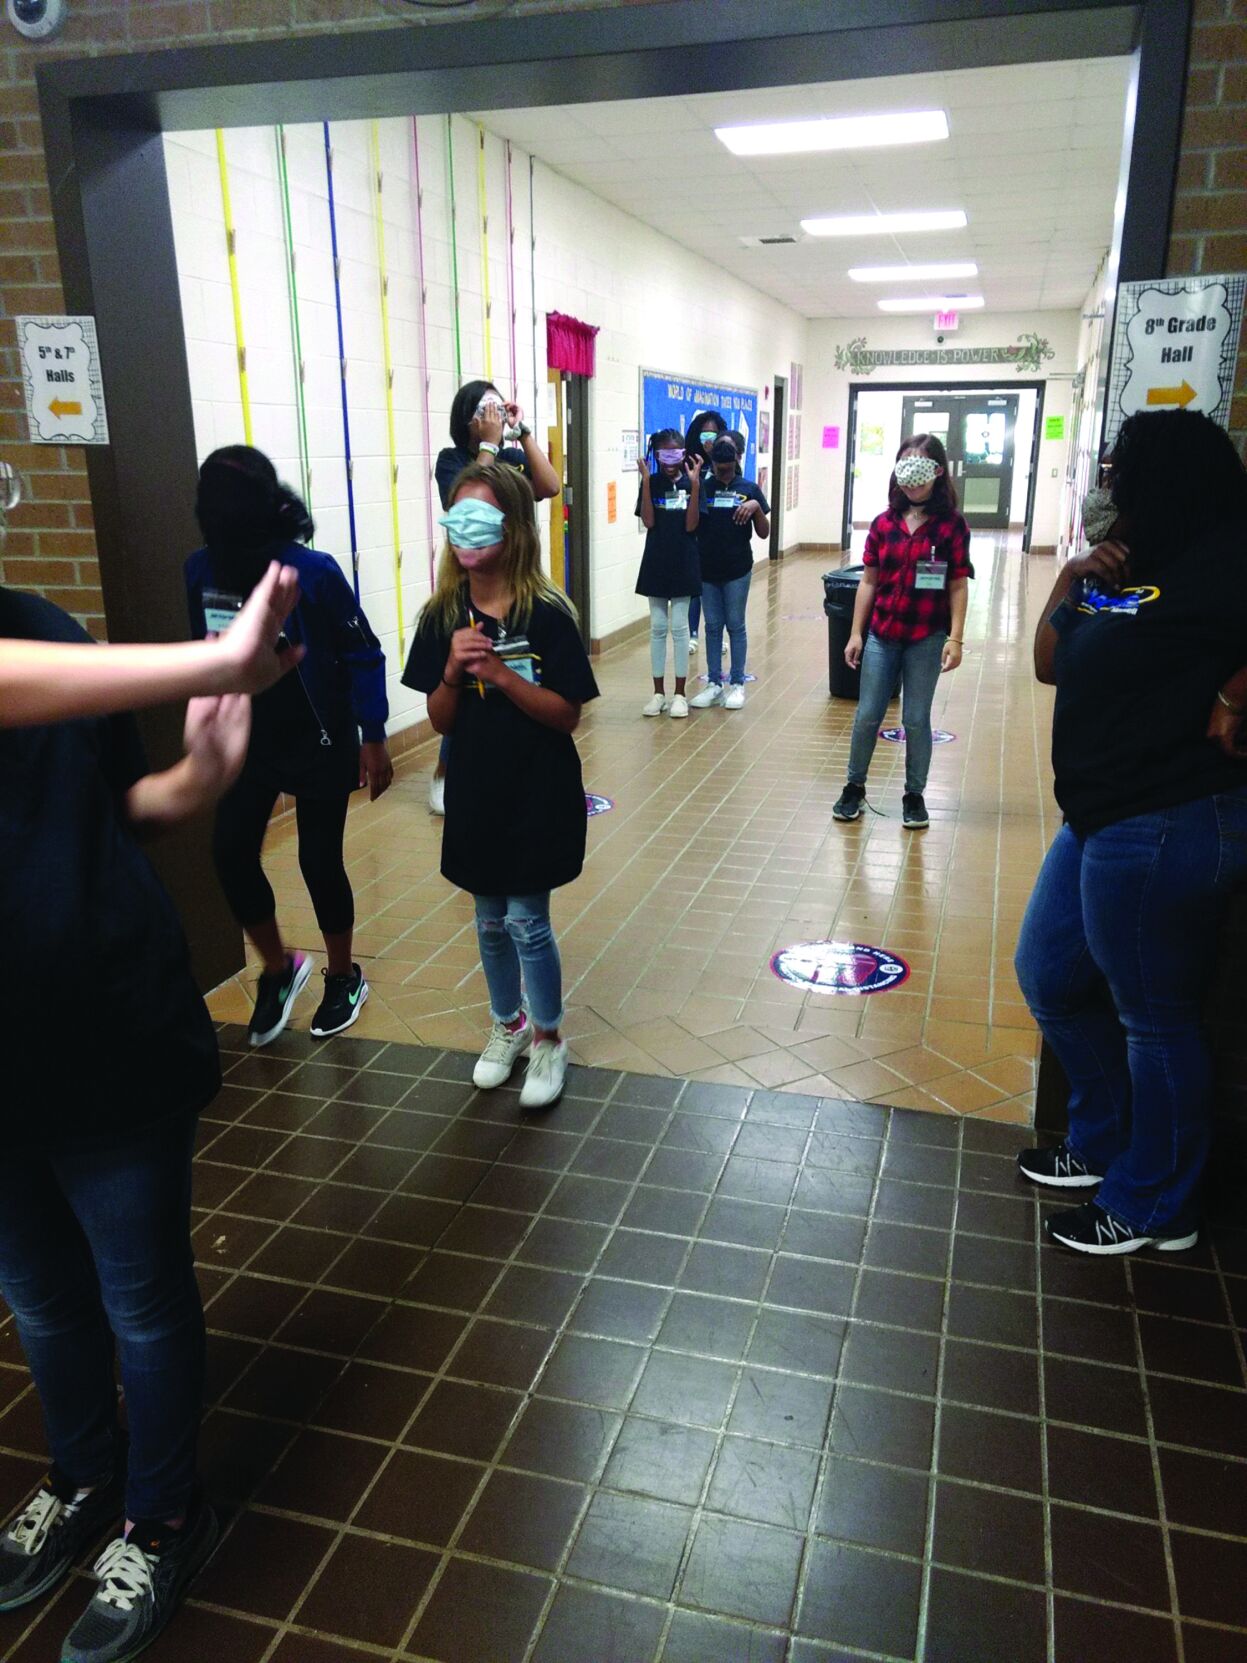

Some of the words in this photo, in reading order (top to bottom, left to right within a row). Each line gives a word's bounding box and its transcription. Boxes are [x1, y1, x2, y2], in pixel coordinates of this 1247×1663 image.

[1145, 317, 1164, 335] 8th
[1167, 315, 1217, 334] Grade
[54, 348, 63, 359] &
[857, 350, 930, 365] KNOWLEDGE
[936, 350, 947, 364] IS
[954, 349, 999, 363] POWER
[1161, 345, 1193, 363] Hall
[45, 368, 75, 383] Halls
[667, 383, 684, 401] WORLD
[685, 386, 693, 402] OF
